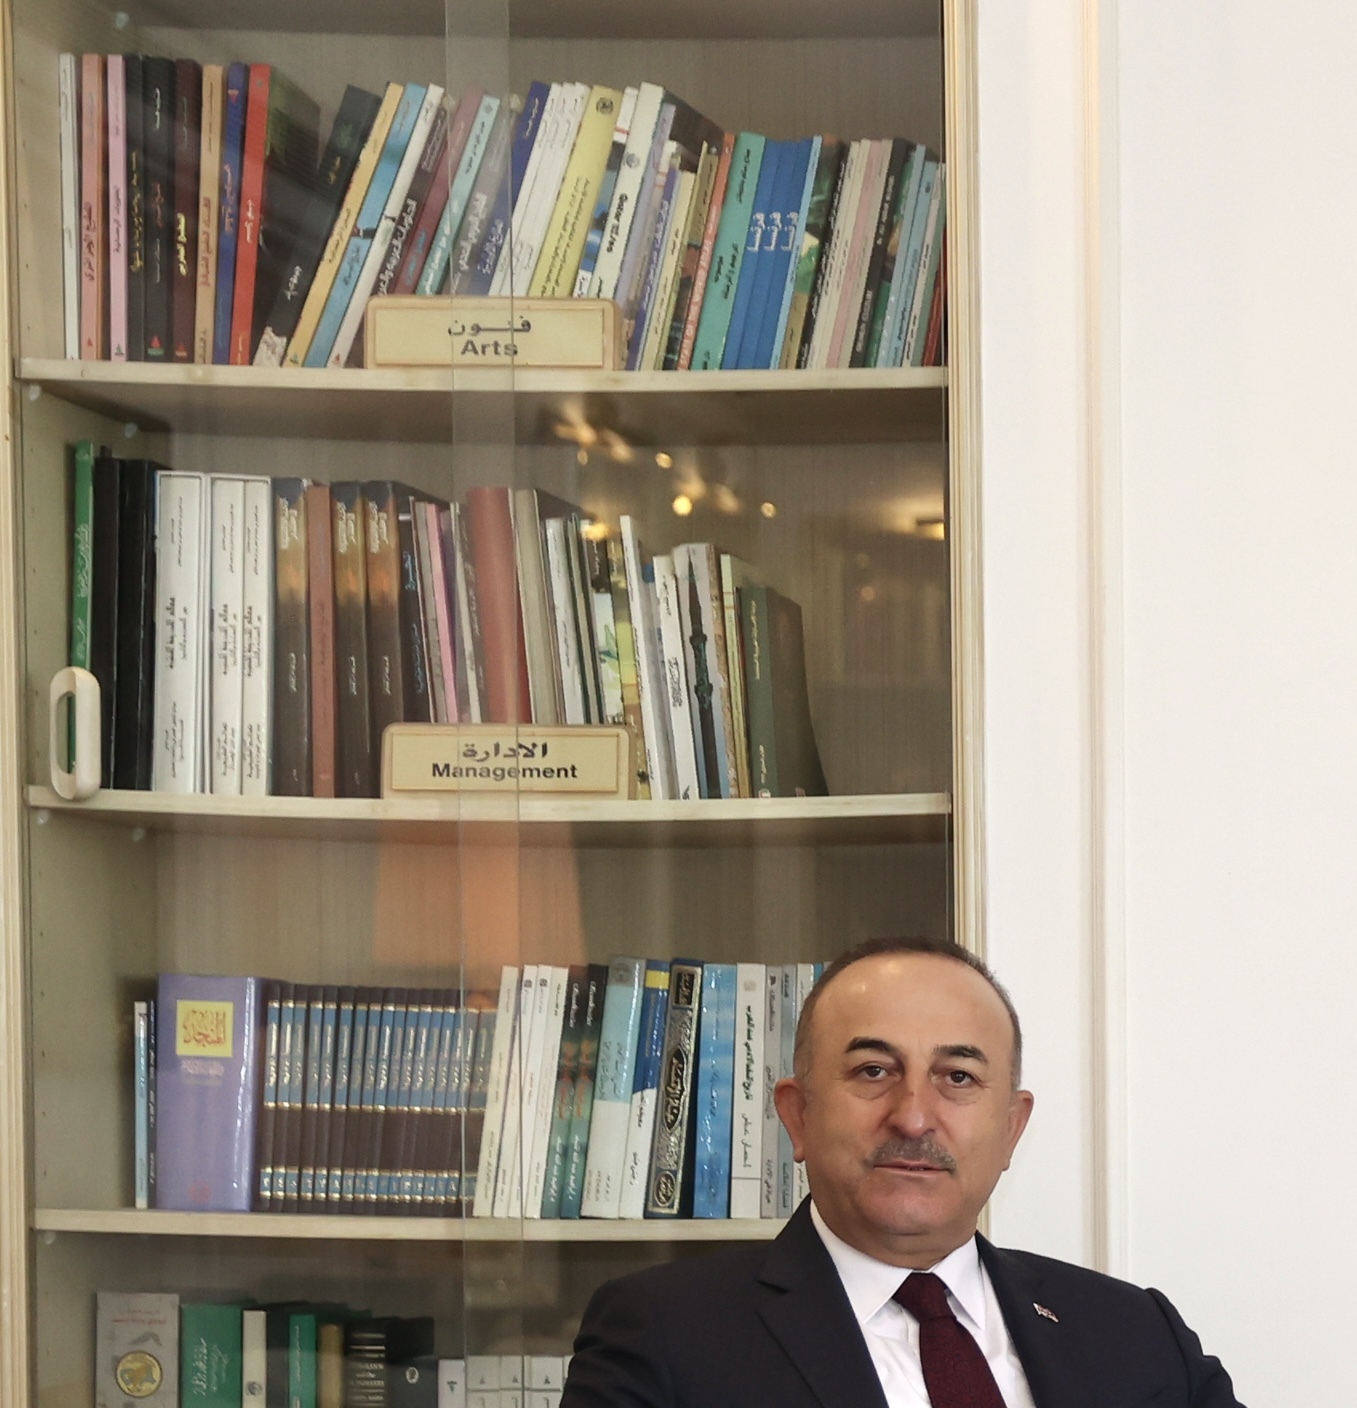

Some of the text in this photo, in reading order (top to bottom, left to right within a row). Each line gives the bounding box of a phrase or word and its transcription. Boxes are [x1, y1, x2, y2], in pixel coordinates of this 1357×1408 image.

[747, 212, 765, 252] فرنسا
[764, 211, 782, 252] فرنسا
[781, 211, 799, 252] فرنسا
[447, 313, 532, 338] فنون
[461, 339, 519, 358] Arts
[462, 740, 549, 763] الادارة
[431, 762, 578, 784] Management
[182, 1010, 226, 1047] المنجد
[745, 1005, 754, 1029] العرب
[742, 1081, 753, 1100] تاريخ
